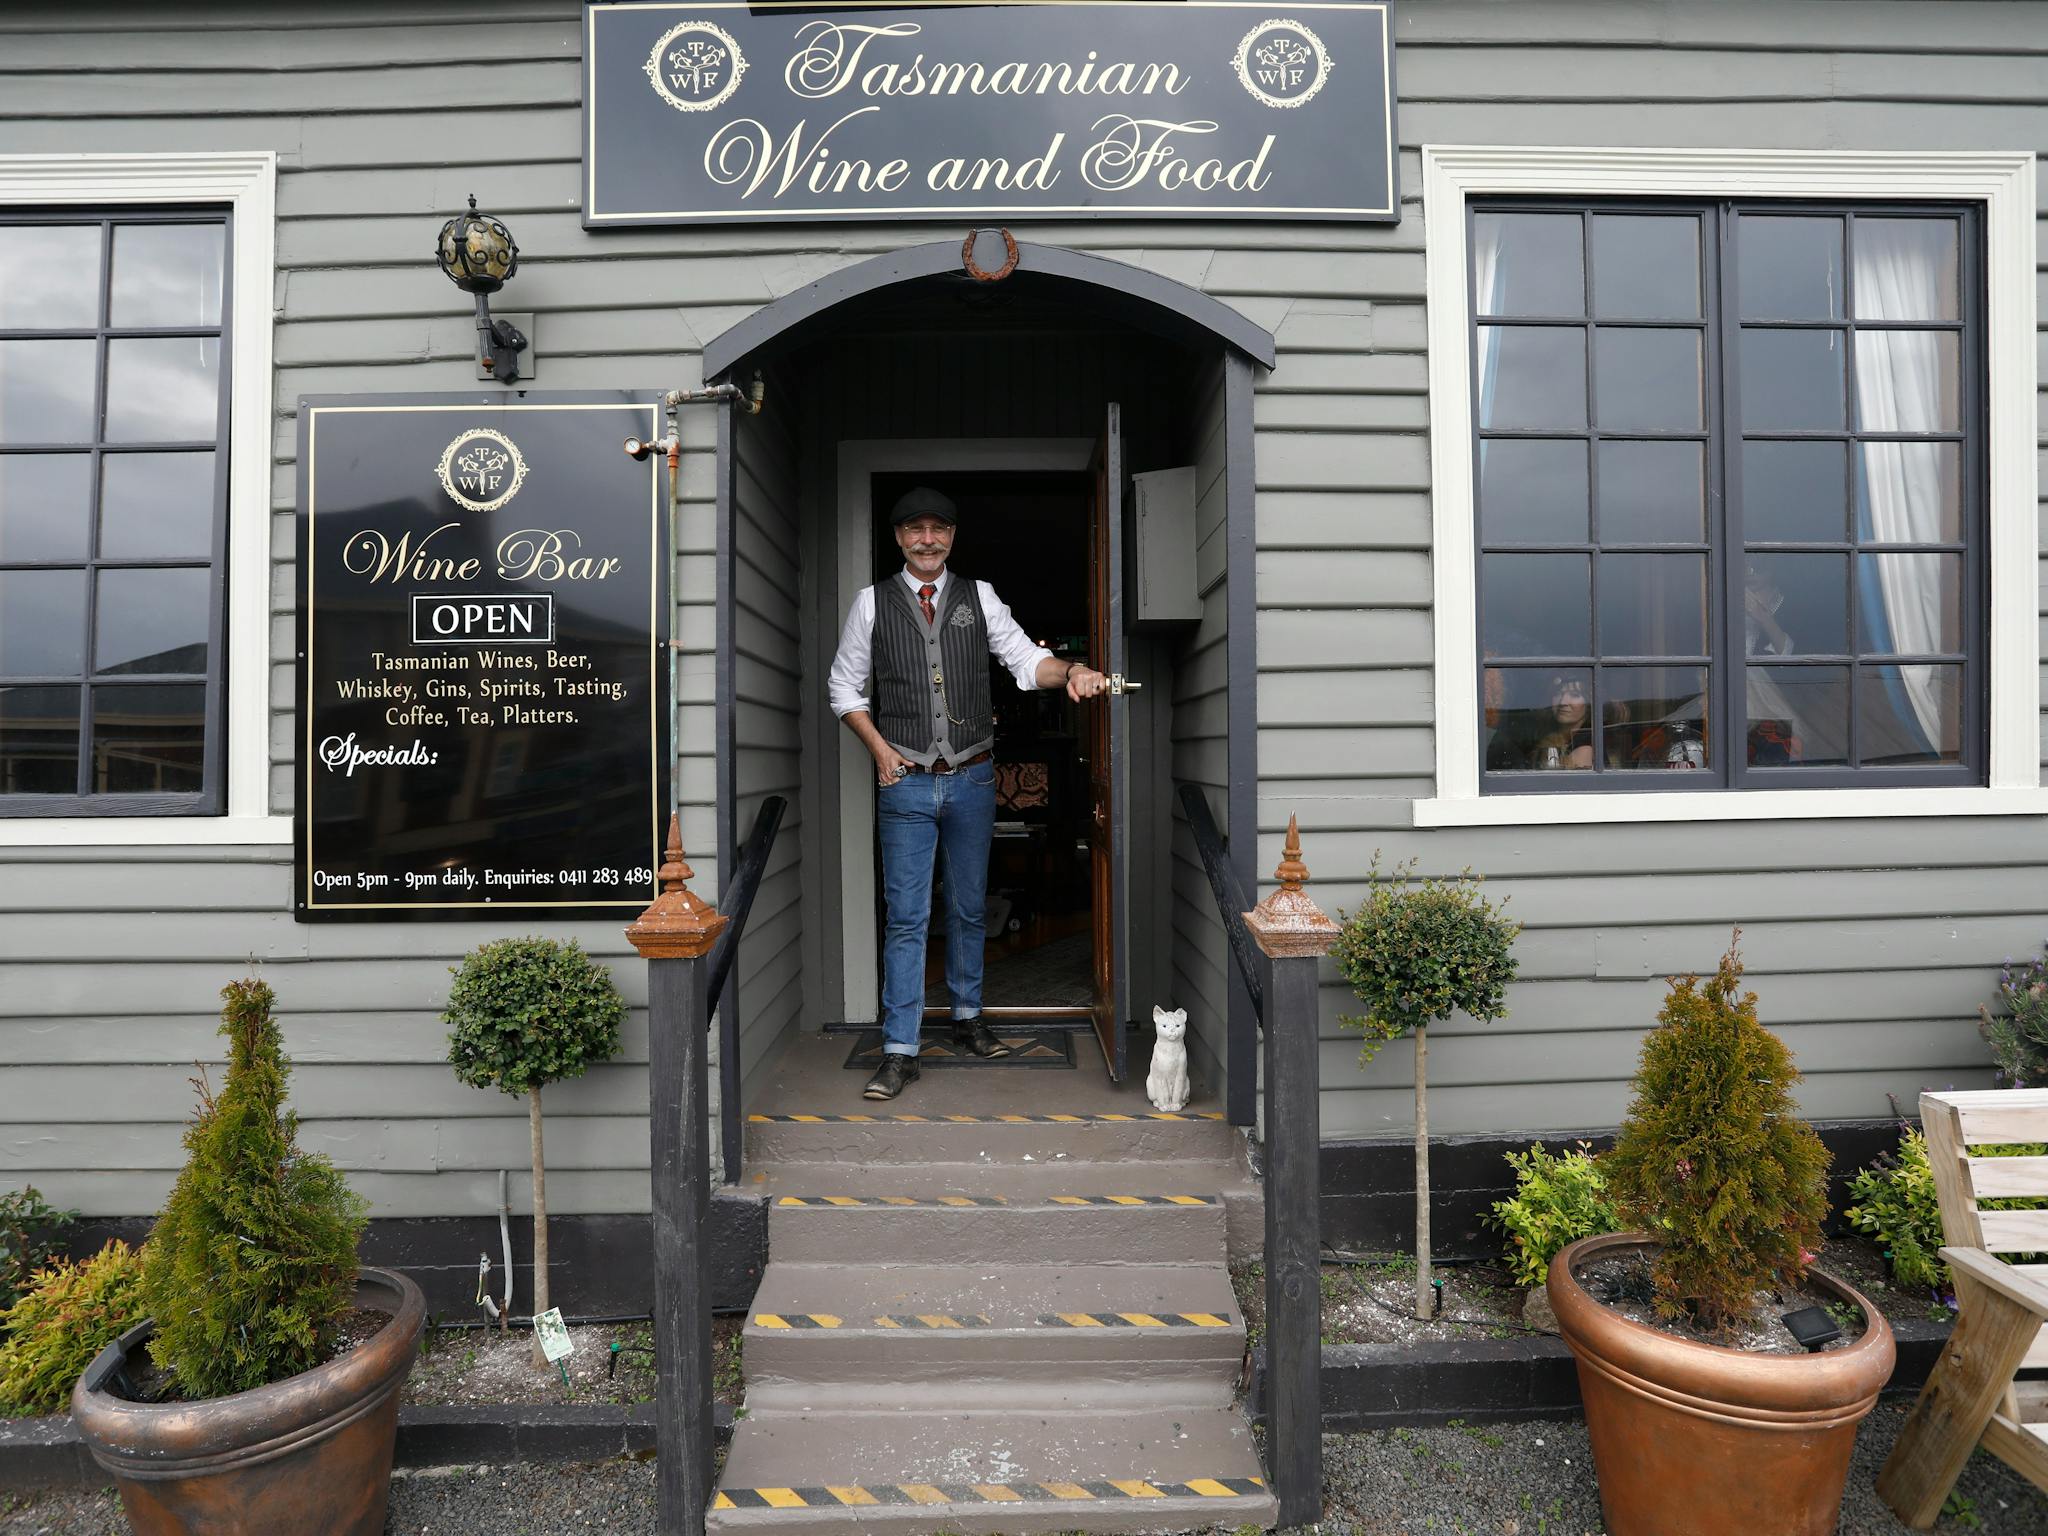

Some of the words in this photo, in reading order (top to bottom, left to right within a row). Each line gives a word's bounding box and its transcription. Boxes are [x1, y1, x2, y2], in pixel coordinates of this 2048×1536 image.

[785, 21, 1190, 98] Tasmanian
[703, 105, 911, 199] Wine
[928, 133, 1065, 190] and
[1081, 114, 1275, 191] Food
[342, 523, 481, 584] Wine
[497, 528, 621, 580] Bar
[433, 604, 532, 634] OPEN
[372, 652, 468, 669] Tasmanian
[478, 651, 537, 670] Wines,
[547, 650, 591, 669] Beer,
[337, 678, 416, 703] Whiskey,
[426, 679, 471, 699] Gins,
[481, 679, 545, 702] Spirits,
[554, 678, 626, 700] Tasting,
[386, 705, 448, 727] Coffee,
[457, 707, 494, 726] Tea,
[504, 704, 578, 723] Platters.
[319, 732, 438, 776] Specials:
[314, 871, 351, 891] Open
[357, 872, 388, 890] 5pm
[405, 872, 436, 890] 9pm
[443, 868, 478, 890] daily.
[485, 869, 553, 889] Enquiries:
[559, 870, 586, 885] 0411
[593, 868, 619, 885] 283
[624, 867, 652, 884] 489
